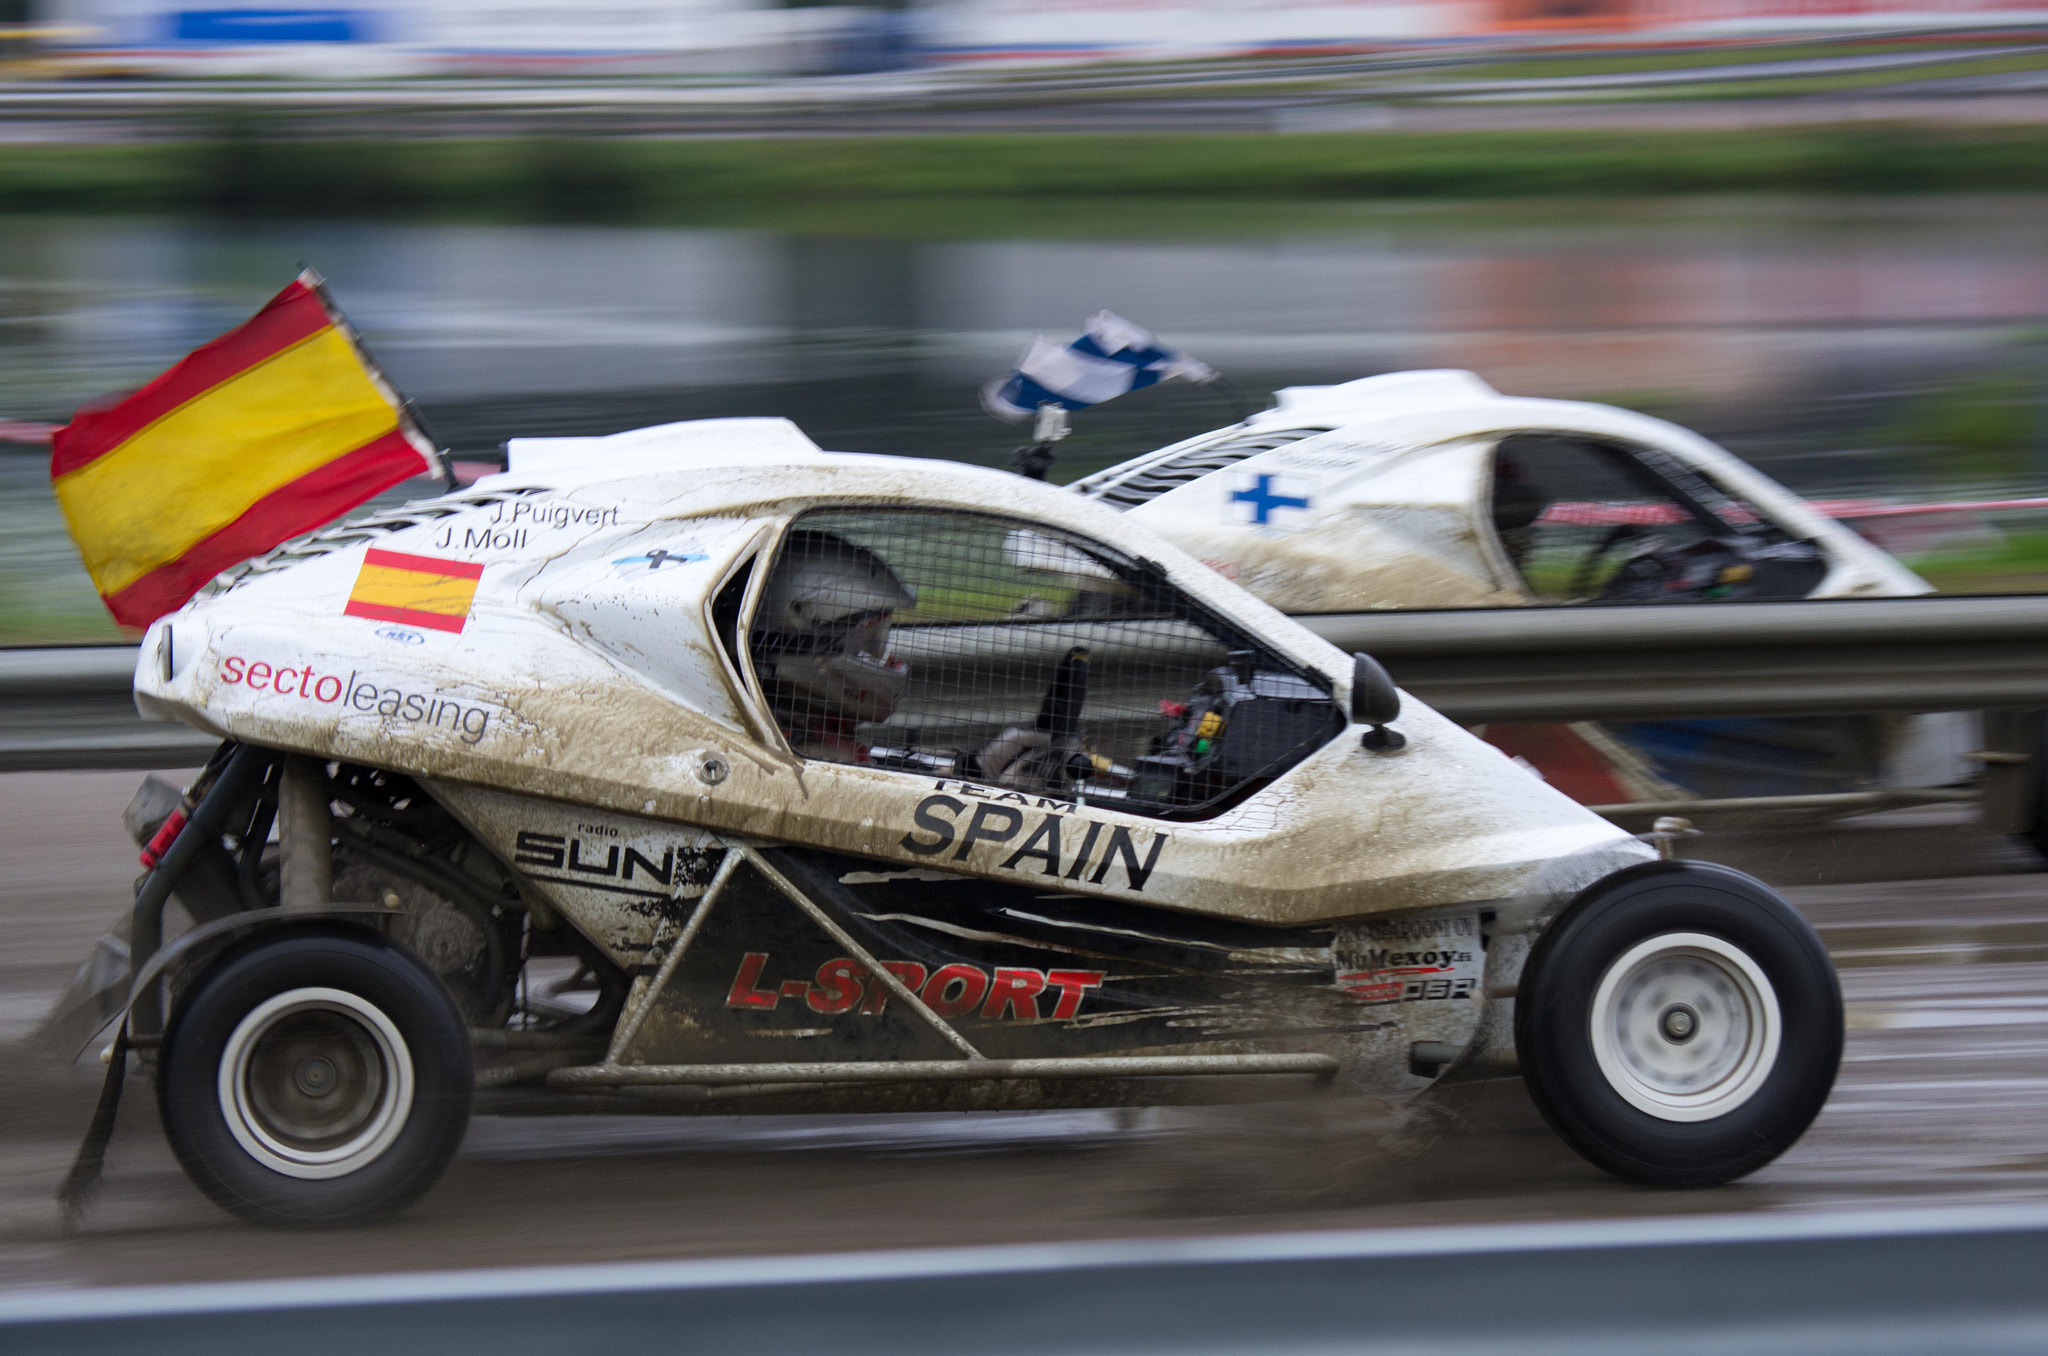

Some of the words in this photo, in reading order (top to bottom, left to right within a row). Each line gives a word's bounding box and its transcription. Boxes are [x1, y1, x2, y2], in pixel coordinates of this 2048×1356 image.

[490, 500, 618, 529] J.Puigvert
[435, 527, 527, 549] J.Moll
[220, 655, 490, 745] sectoleasing
[934, 779, 1077, 814] TEAM
[577, 822, 619, 838] radio
[898, 794, 1169, 892] SPAIN
[514, 831, 674, 885] SUN
[724, 950, 1109, 1022] L-SPORT
